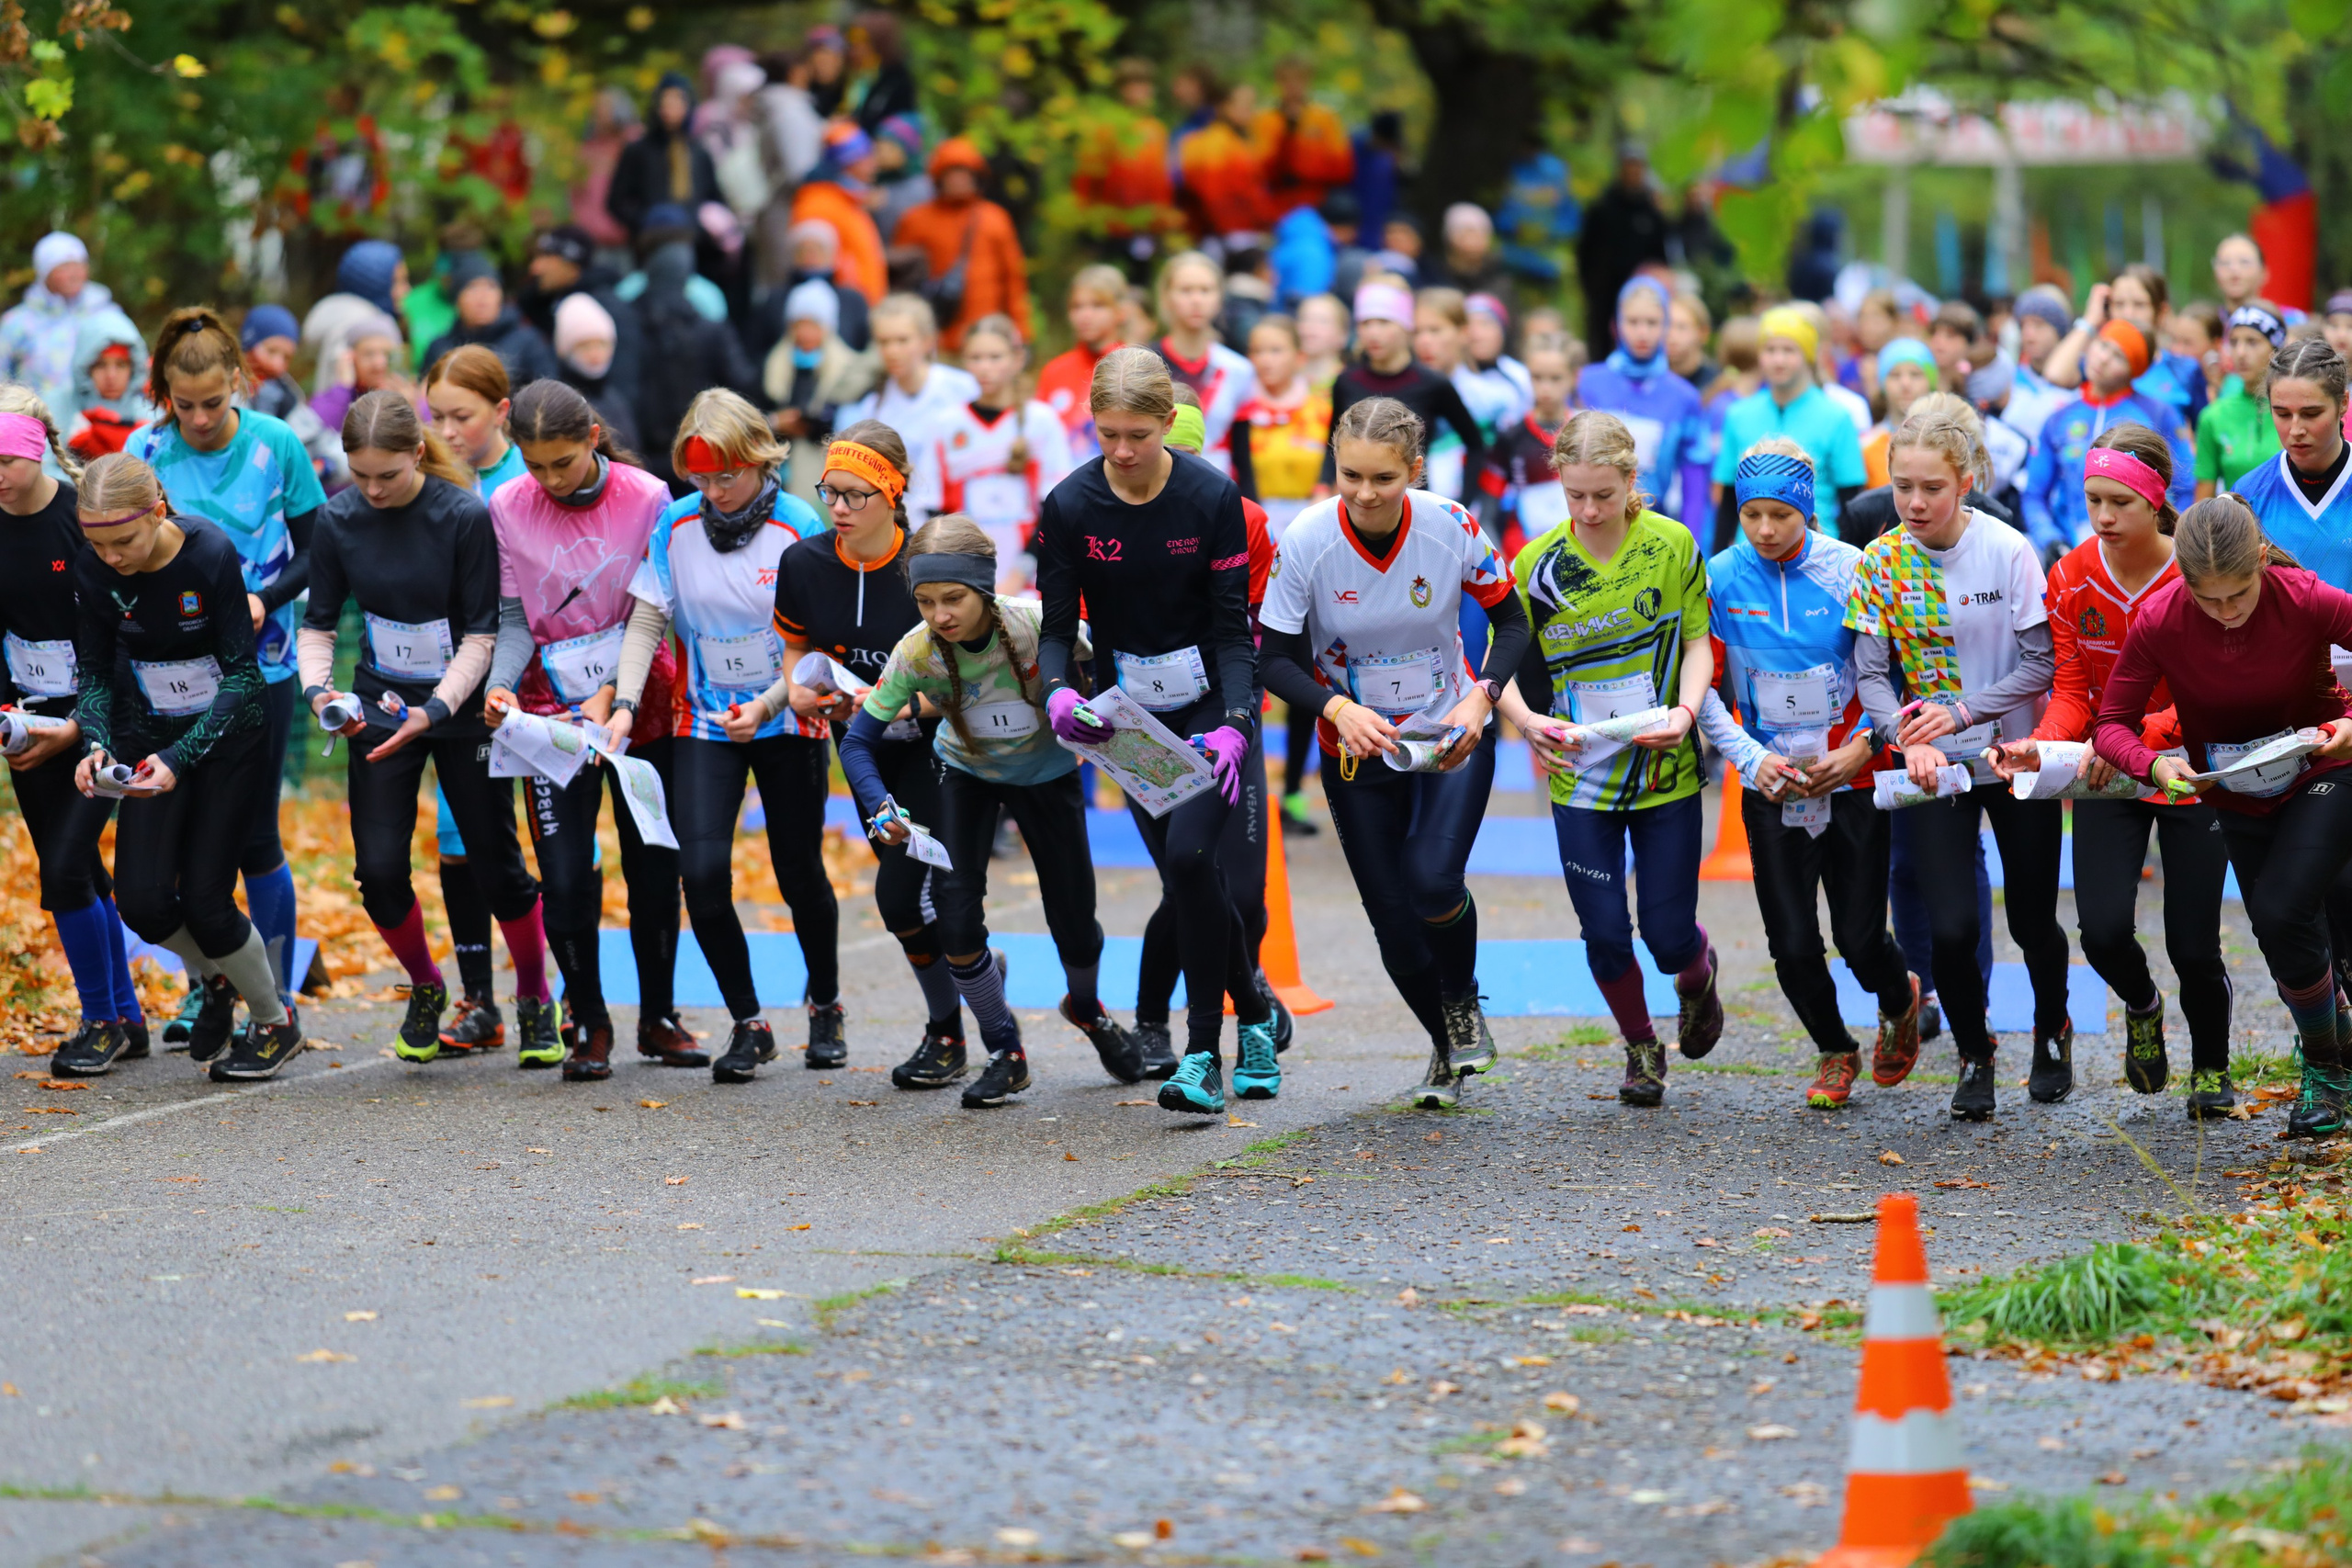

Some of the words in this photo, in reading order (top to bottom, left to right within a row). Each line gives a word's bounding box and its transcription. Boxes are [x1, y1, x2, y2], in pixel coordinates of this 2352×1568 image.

[1167, 536, 1201, 548] ENERGY
[1170, 545, 1197, 555] GROUP
[1544, 606, 1632, 640] ФЕНИКС
[396, 645, 412, 659] 17
[27, 663, 44, 677] 20
[725, 658, 744, 671] 15
[583, 664, 605, 679] 16
[169, 680, 189, 694] 18
[1152, 680, 1164, 693] 8
[1391, 681, 1401, 694] 7
[1786, 695, 1796, 709] 5
[992, 715, 1009, 727] 11
